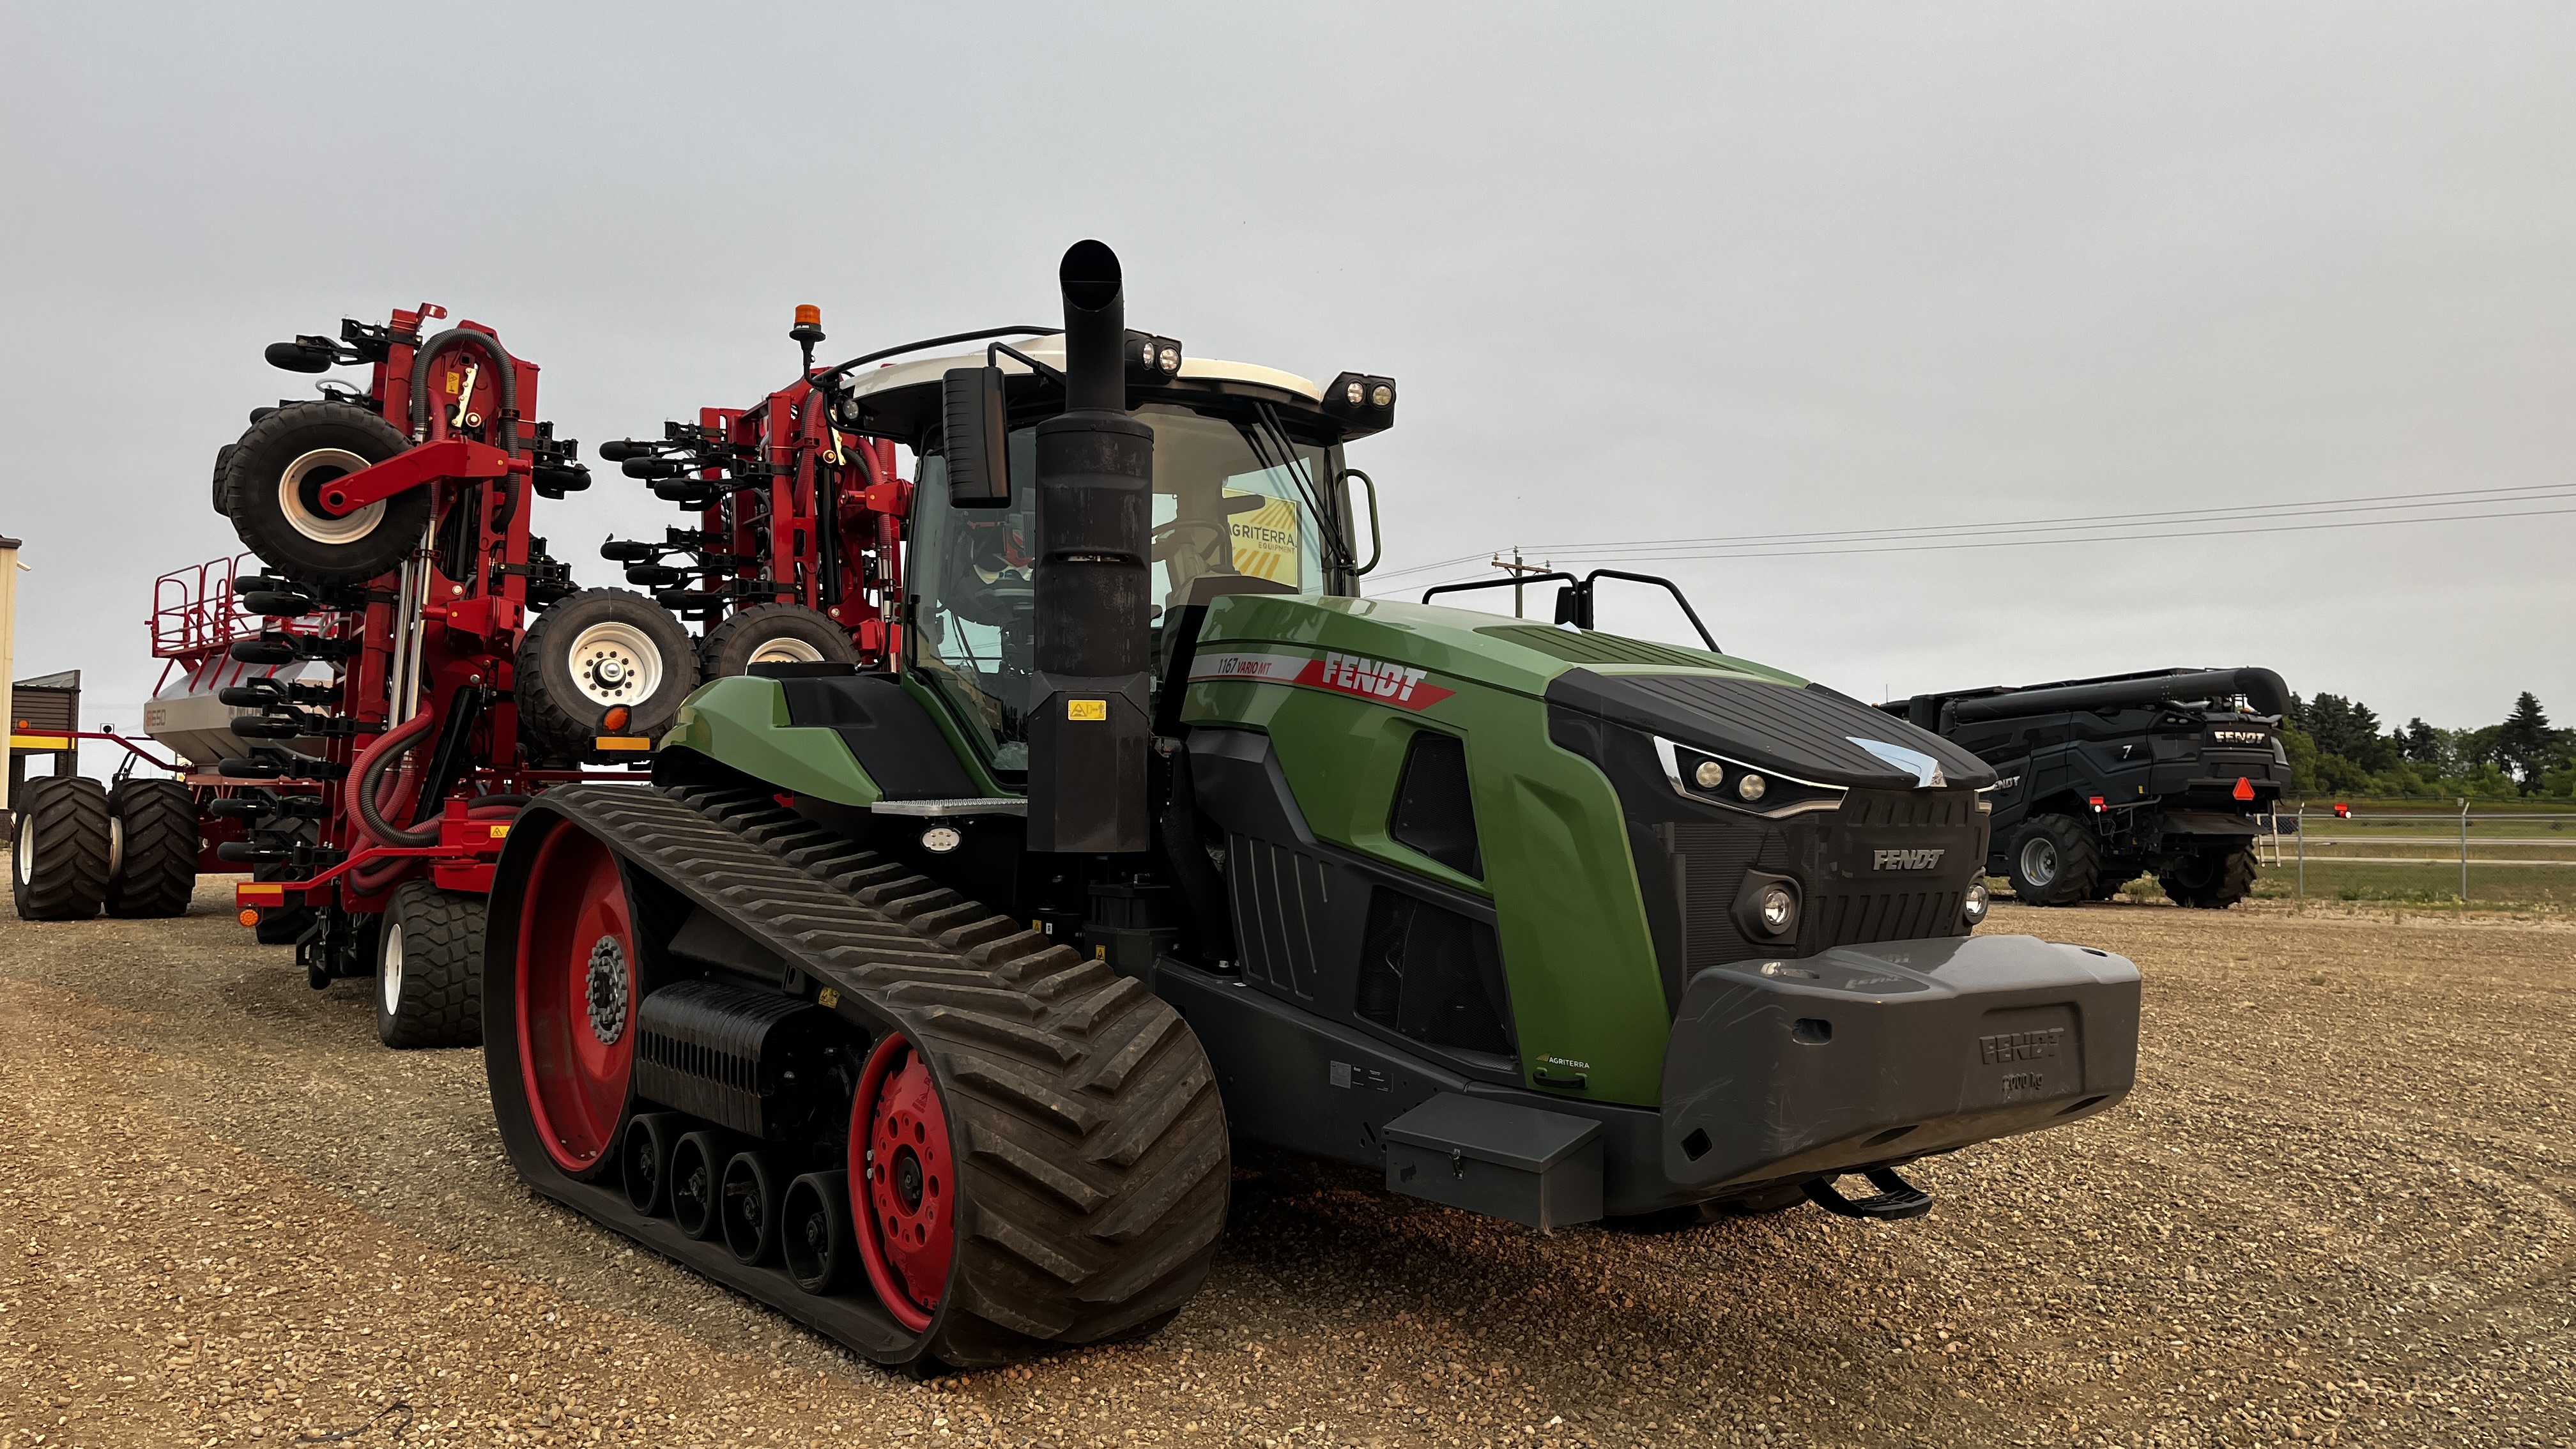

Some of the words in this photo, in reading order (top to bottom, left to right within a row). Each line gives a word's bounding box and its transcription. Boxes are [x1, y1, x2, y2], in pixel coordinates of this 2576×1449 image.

[1259, 542, 1296, 554] EQUIPMENT
[1218, 657, 1239, 674] 1167
[1237, 661, 1259, 674] VARIO
[1258, 662, 1272, 675] MT
[1322, 651, 1427, 702] FENDT
[2214, 731, 2266, 744] FENDT
[2122, 744, 2133, 759] 7
[1993, 776, 2020, 791] ENDT
[1873, 849, 1945, 870] FENDT
[1979, 1027, 2064, 1064] FENDT
[1549, 1057, 1590, 1069] AGRITERRA
